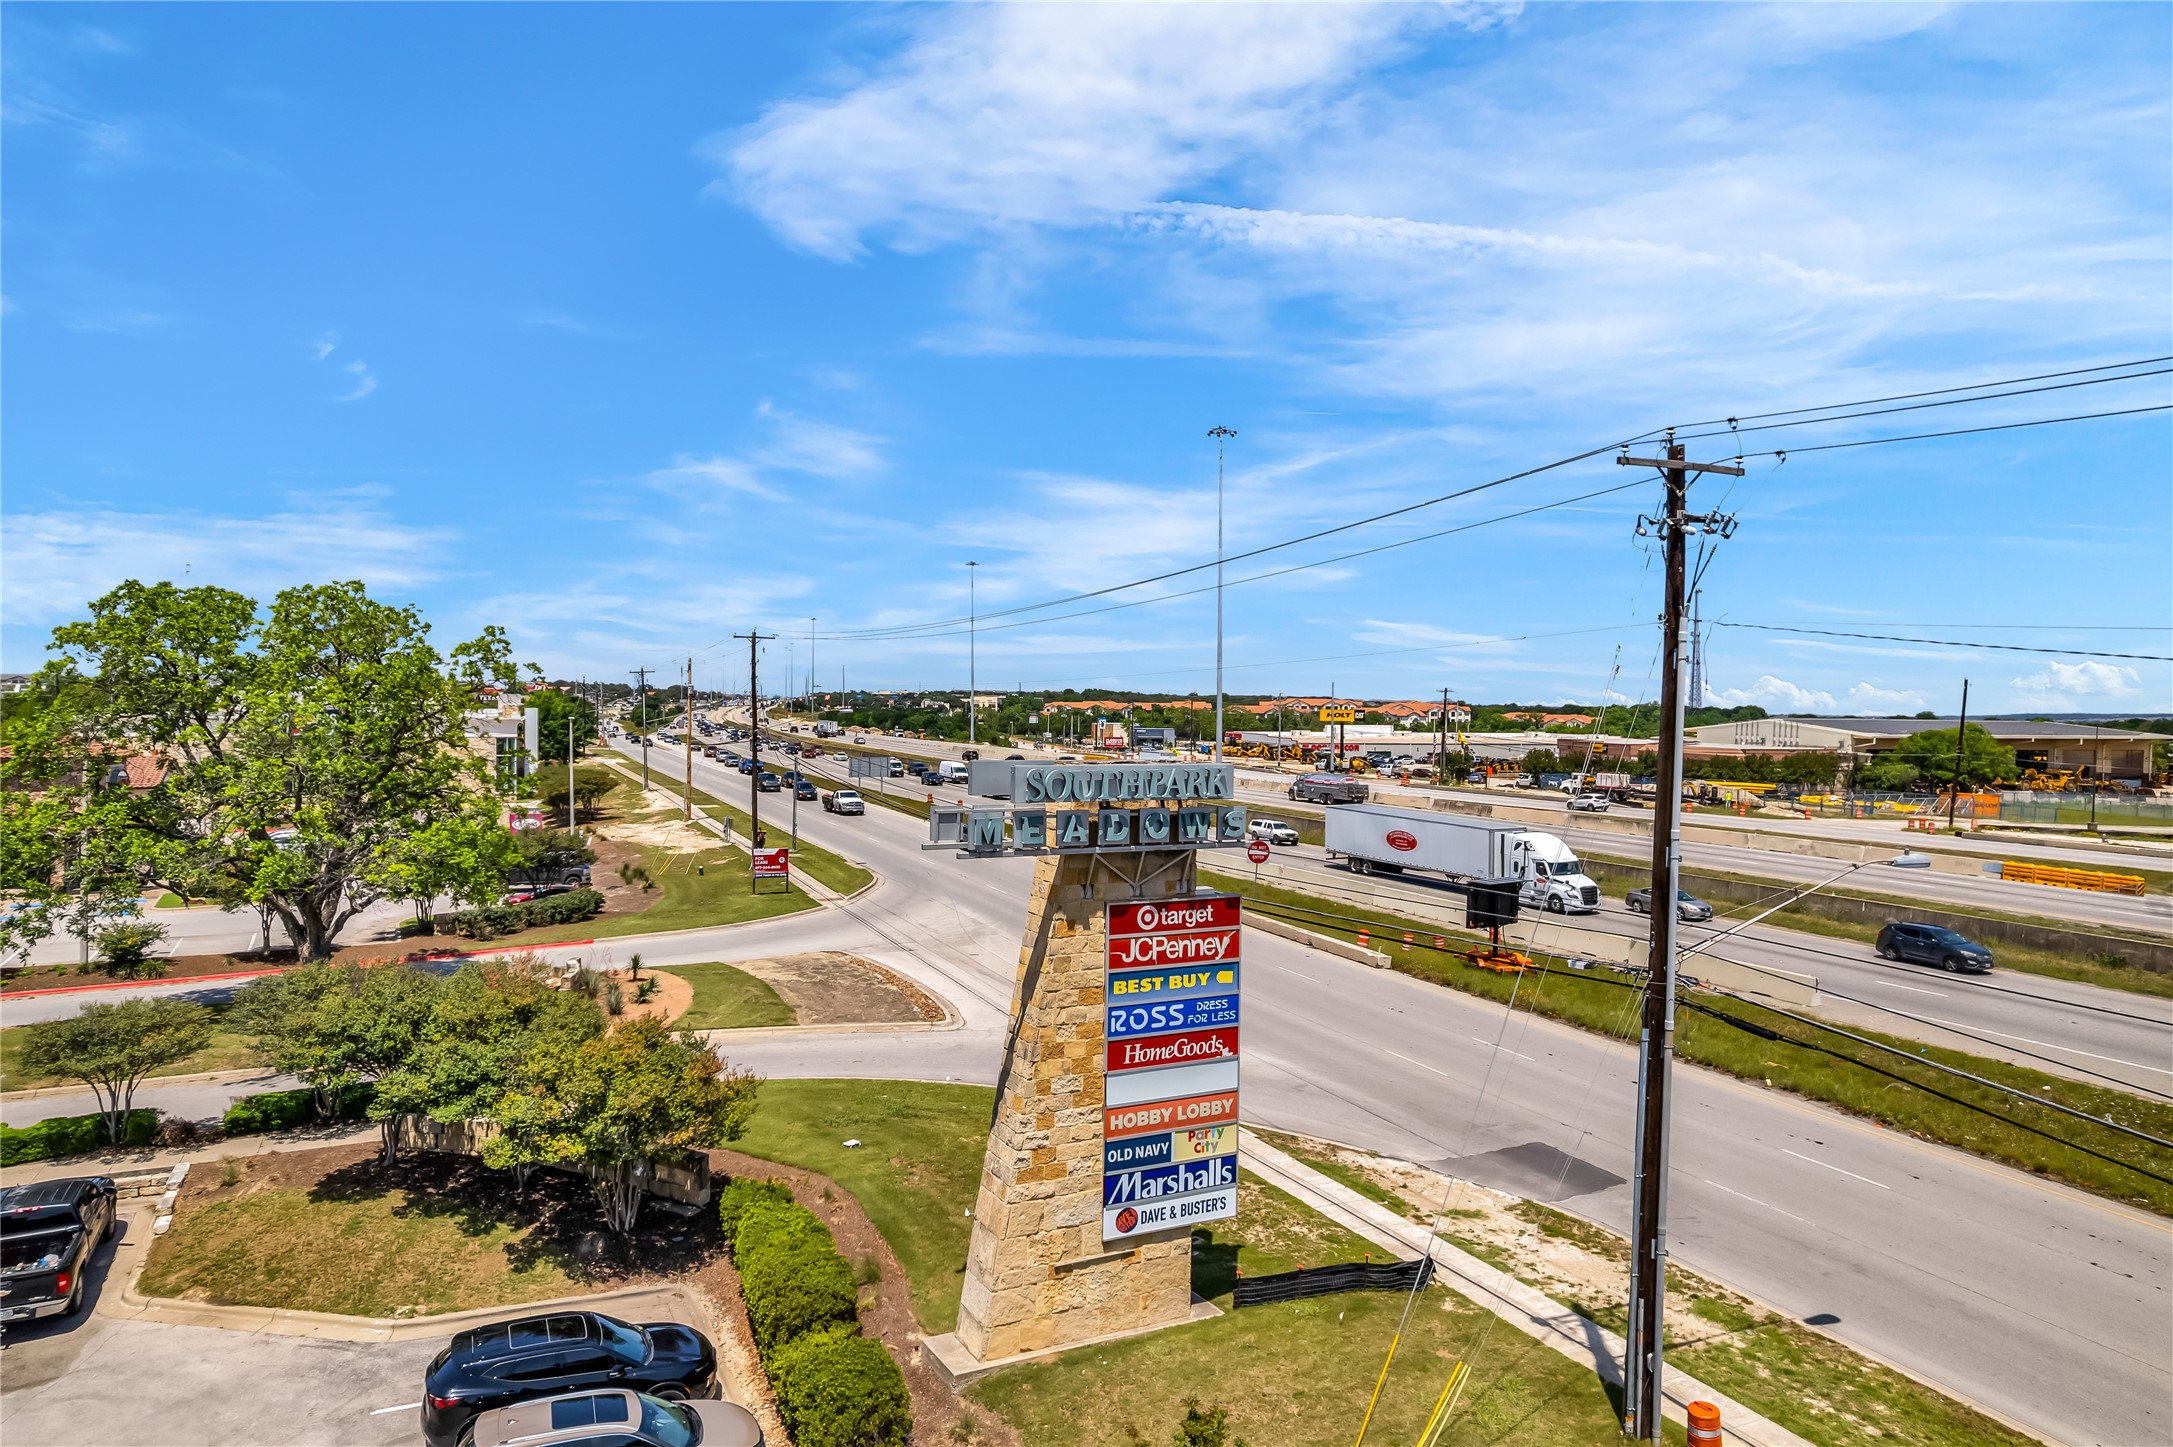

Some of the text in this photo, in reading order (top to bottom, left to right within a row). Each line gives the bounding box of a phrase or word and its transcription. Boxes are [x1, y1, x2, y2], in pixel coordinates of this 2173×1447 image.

[1025, 767, 1231, 801] SOUTHPARK
[974, 809, 1245, 846] MEADOWS
[1160, 905, 1214, 927] target
[1110, 931, 1236, 964] JCPenney
[1113, 972, 1211, 995] BEST BUY
[1110, 1004, 1184, 1033] ROSS
[1187, 1010, 1237, 1025] FOR LESS
[1196, 999, 1229, 1011] DRESS
[1123, 1035, 1223, 1065] HomeGoods
[1110, 1098, 1234, 1131] HOBBY LOBBY
[1107, 1142, 1170, 1163] OLD NAVY
[1194, 1141, 1219, 1154] City
[1108, 1158, 1233, 1205] Marshalls
[1140, 1206, 1166, 1225] DAVE
[1169, 1205, 1177, 1219] &
[1180, 1196, 1227, 1218] BUSTER'S
